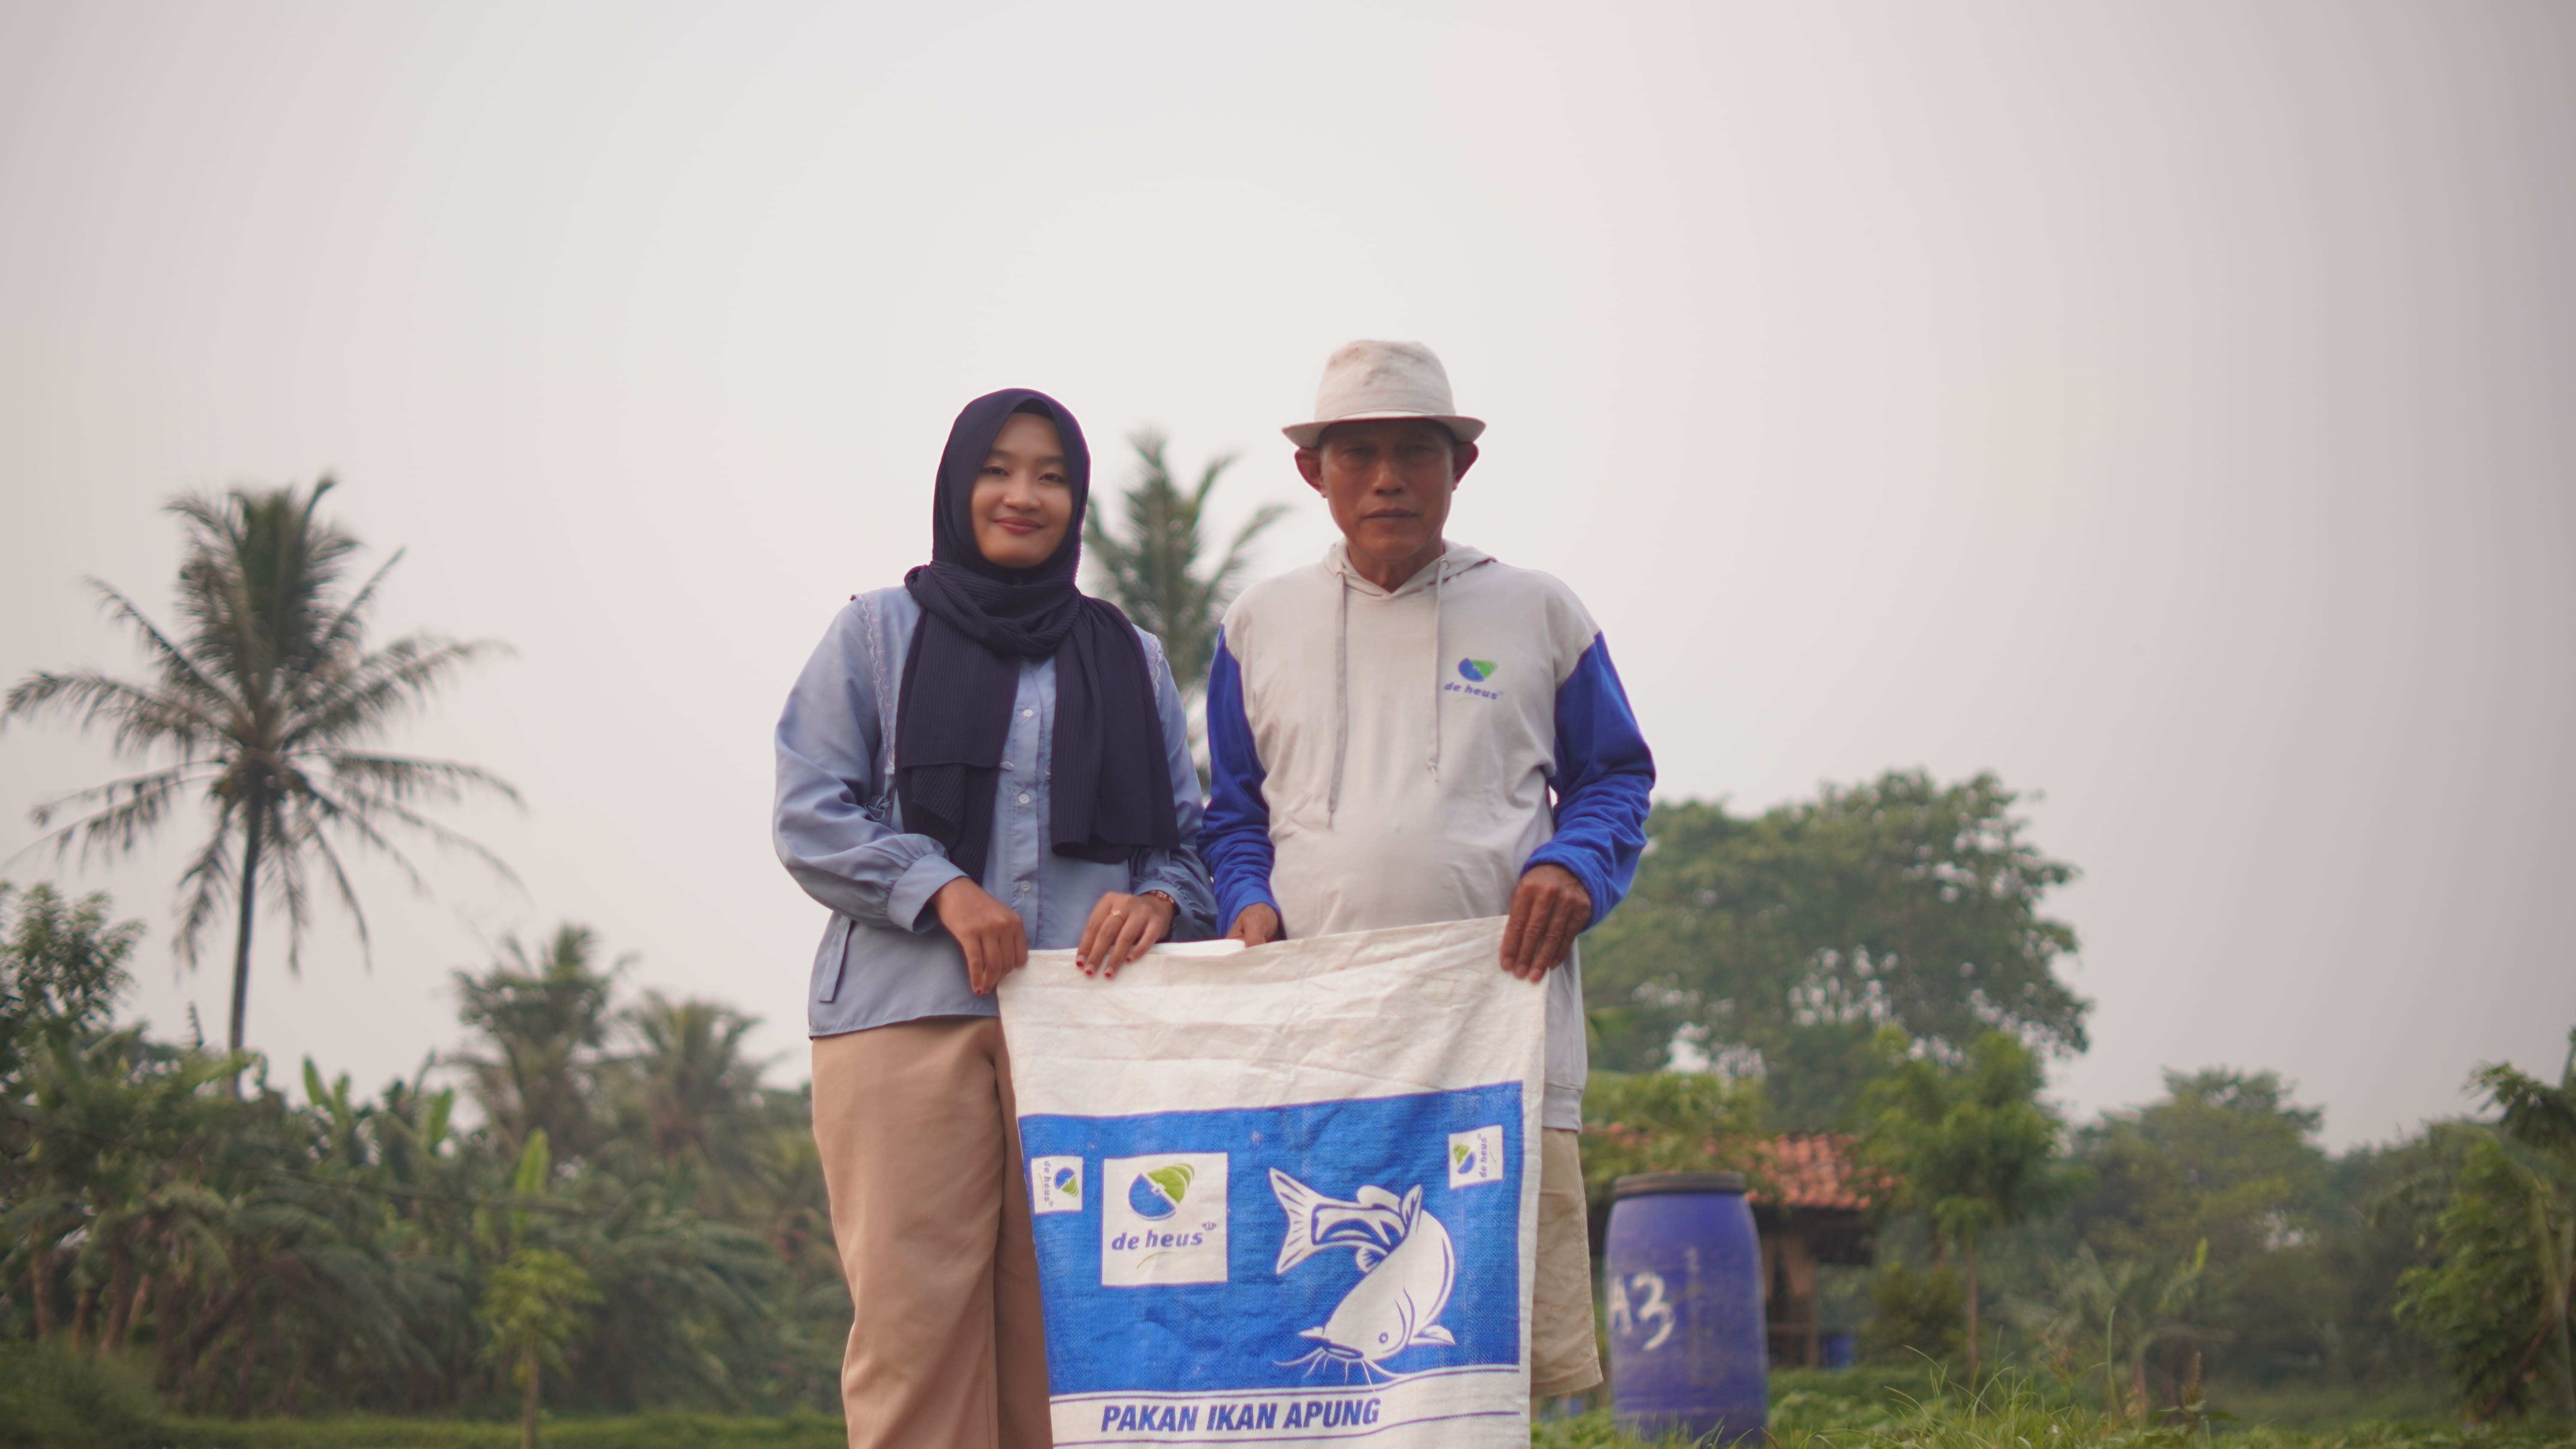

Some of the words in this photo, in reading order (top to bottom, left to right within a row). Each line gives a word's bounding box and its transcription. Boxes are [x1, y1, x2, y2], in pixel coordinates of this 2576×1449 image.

[1443, 682, 1461, 692] de
[1464, 684, 1498, 700] heus
[1044, 1161, 1051, 1173] de
[1479, 1165, 1487, 1178] de
[1111, 1232, 1140, 1250] de
[1145, 1229, 1203, 1248] heus
[1609, 1271, 1675, 1351] A3
[1101, 1404, 1200, 1432] PAKAN
[1206, 1403, 1279, 1431] IKAN
[1282, 1397, 1382, 1429] APUNG
